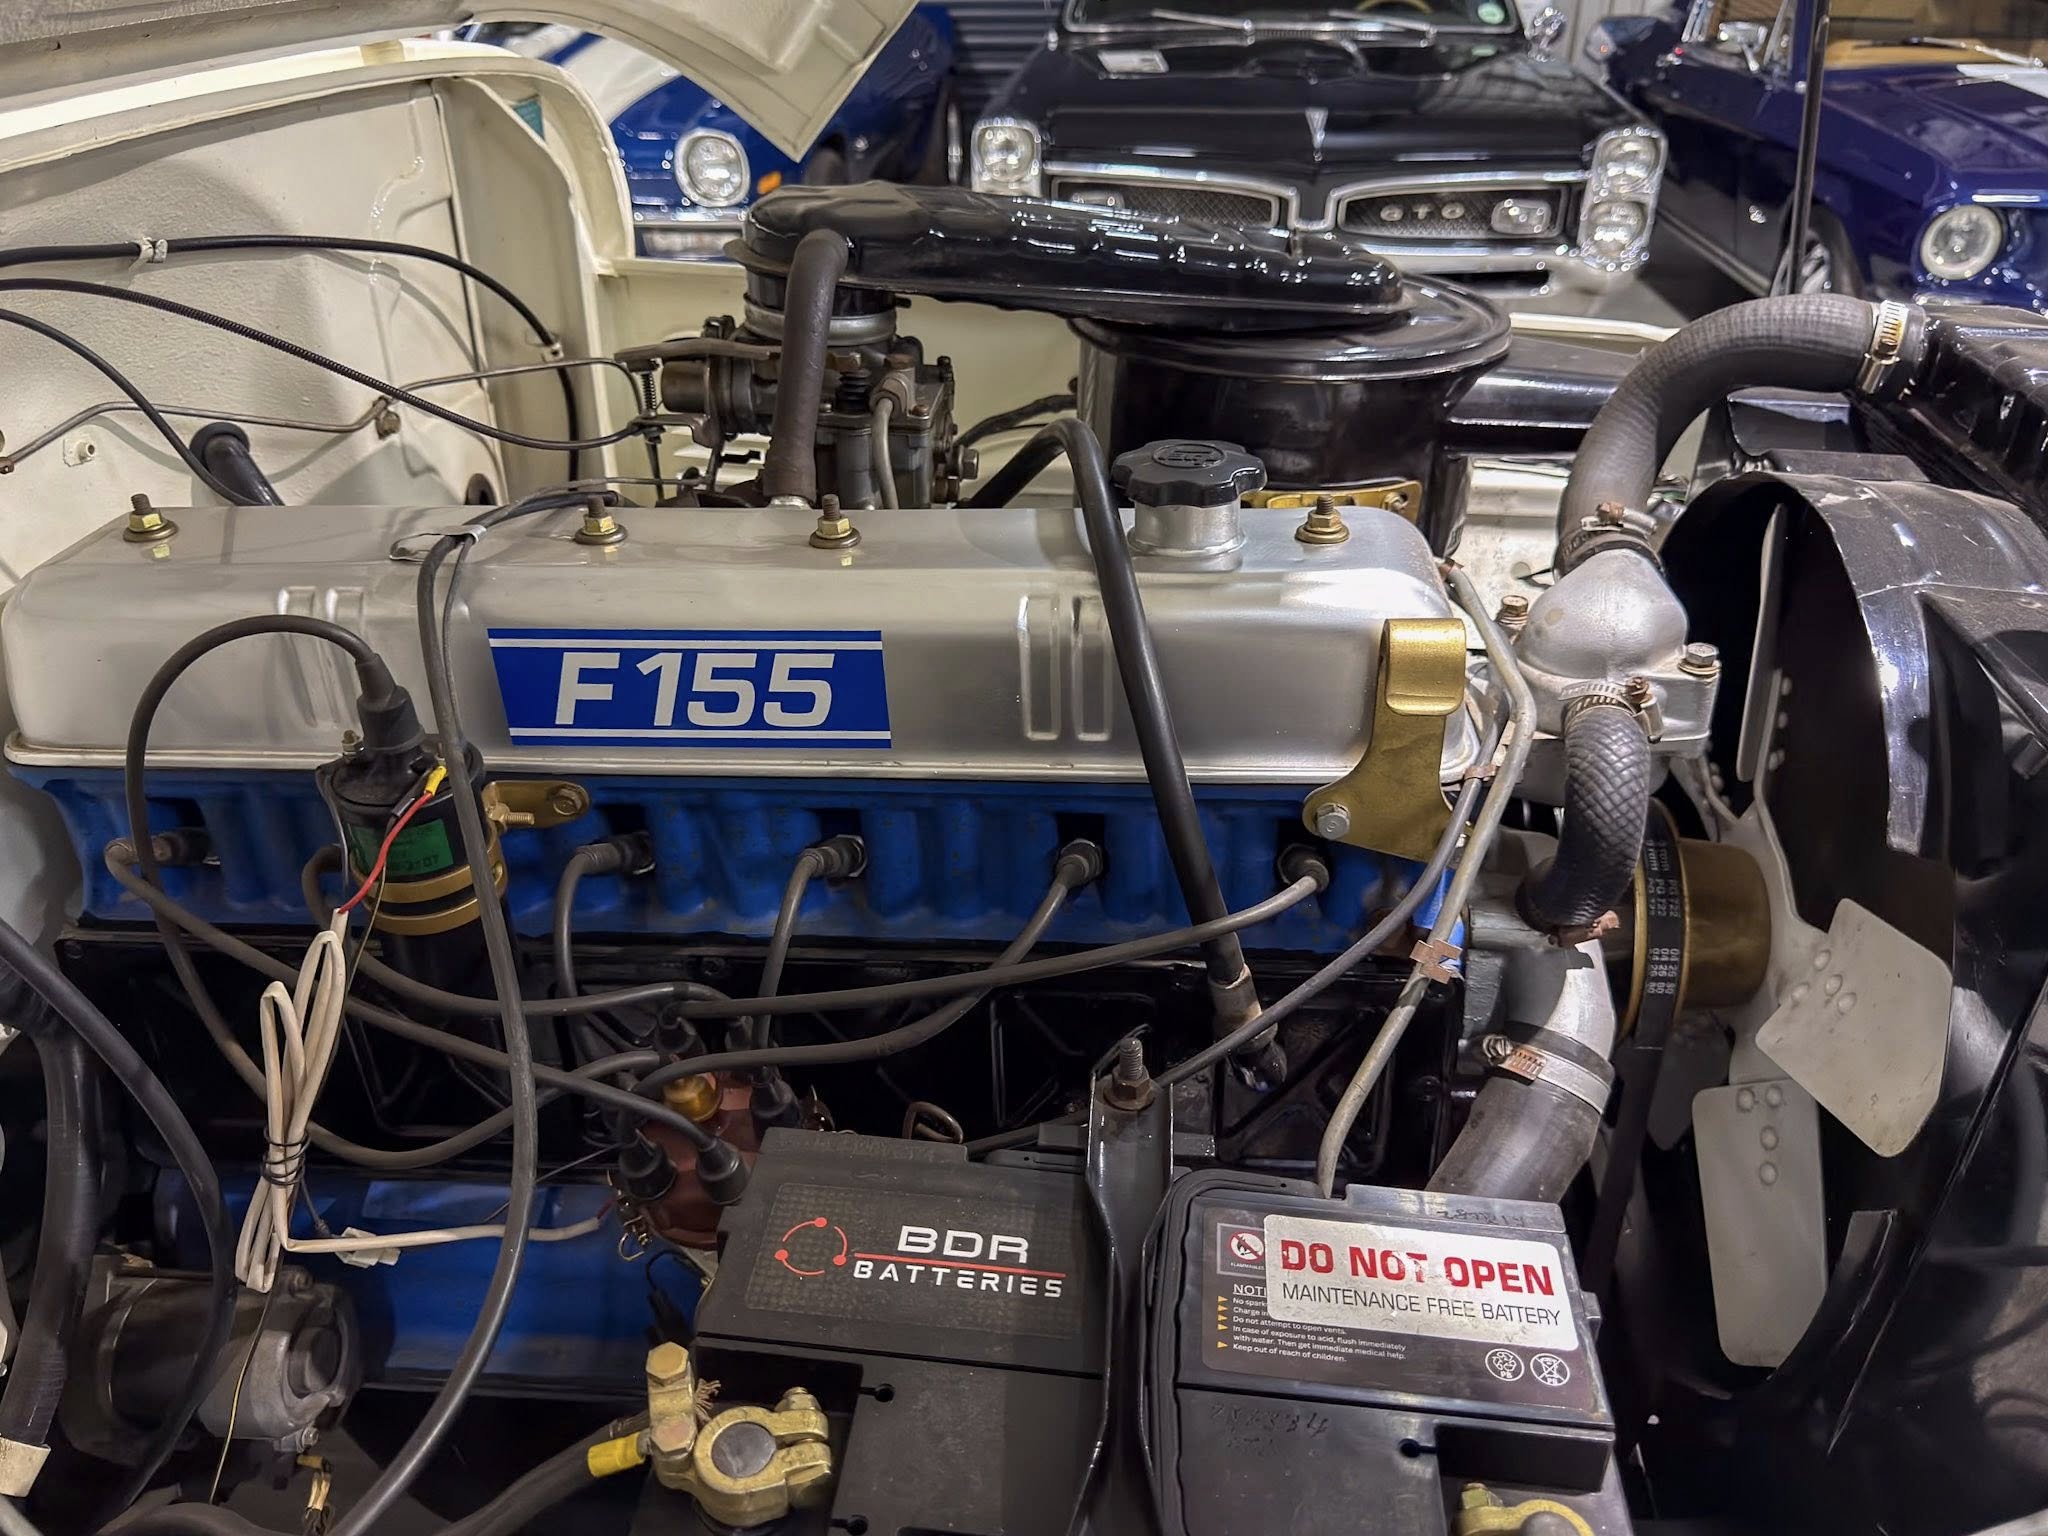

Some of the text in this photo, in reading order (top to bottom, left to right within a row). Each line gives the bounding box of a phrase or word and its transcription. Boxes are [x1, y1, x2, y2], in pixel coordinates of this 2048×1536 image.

[555, 651, 836, 728] F 155
[897, 1225, 1029, 1264] BDR
[1280, 1239, 1555, 1296] DO NOT OPEN
[853, 1260, 1063, 1298] BATTERIES
[1233, 1284, 1267, 1297] NOTI
[1233, 1307, 1260, 1316] Charge
[1282, 1283, 1561, 1326] MAINTENANCE FREE BATTERY
[1260, 1320, 1291, 1329] attempt
[1233, 1343, 1253, 1352] Keep
[1279, 1349, 1301, 1357] reach
[1270, 1331, 1306, 1340] exposure
[1337, 1337, 1357, 1345] flush
[1358, 1339, 1407, 1352] immediately
[1277, 1339, 1297, 1347] Then
[1298, 1342, 1311, 1350] get
[1312, 1343, 1353, 1354] immediate
[1354, 1348, 1386, 1357] medical
